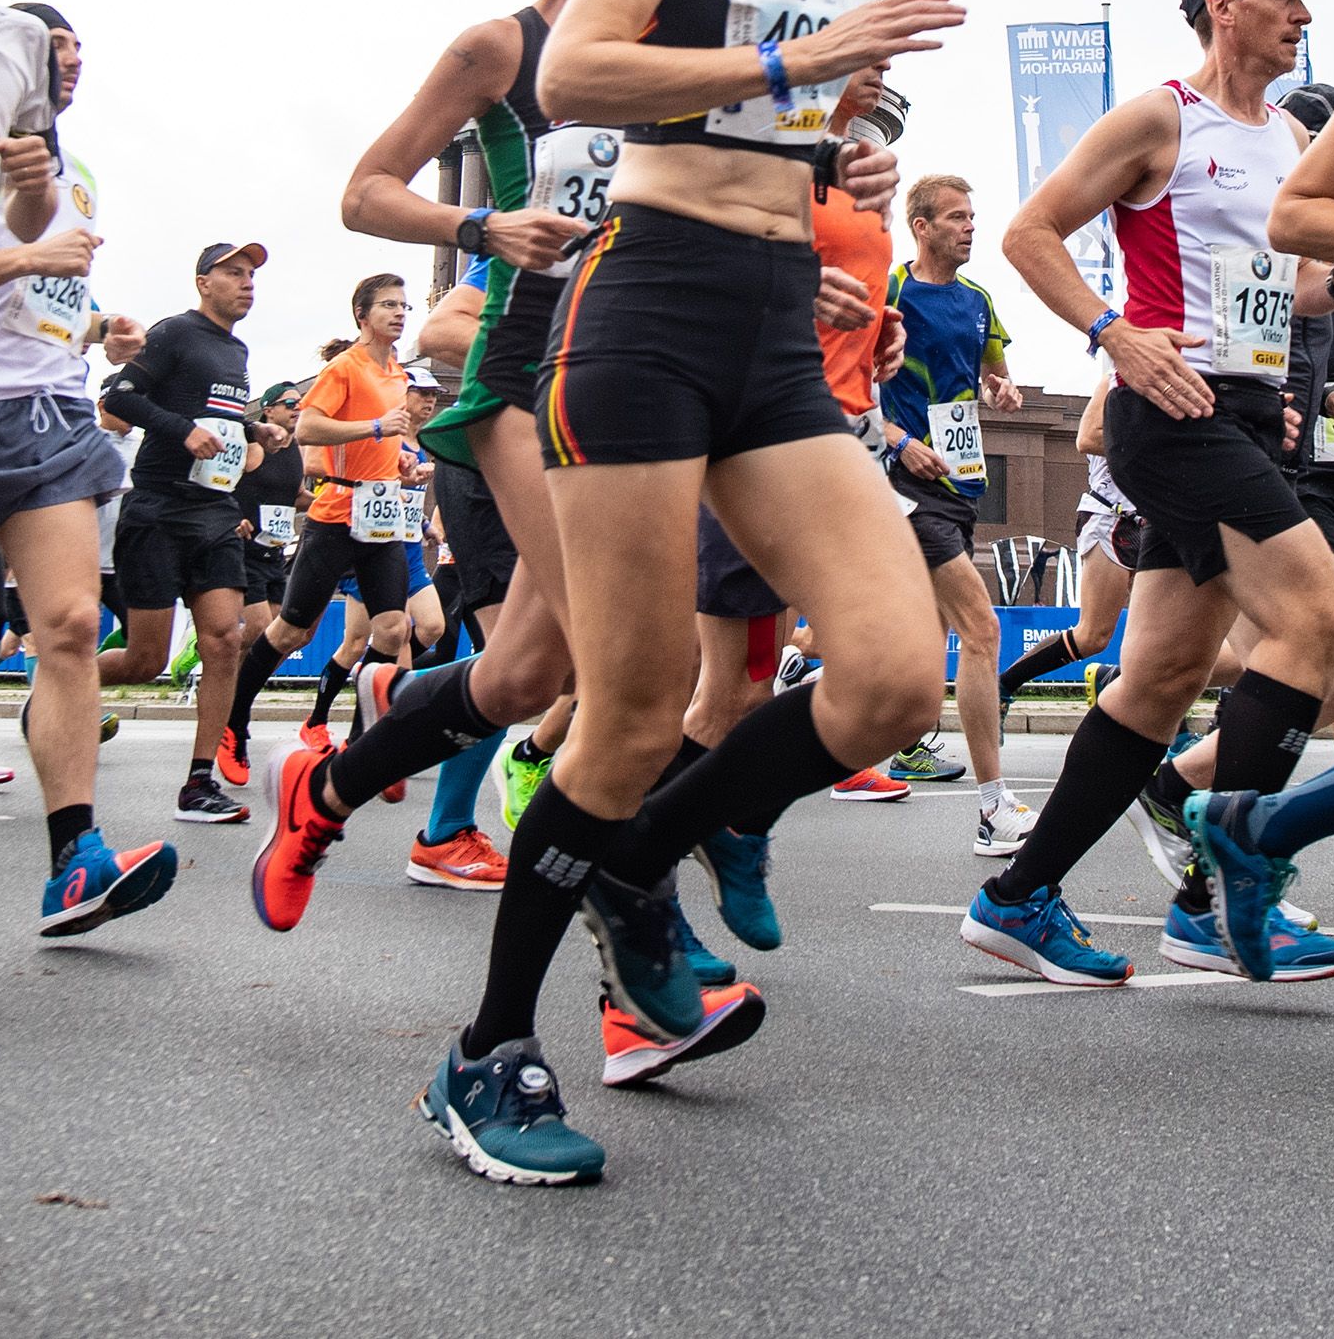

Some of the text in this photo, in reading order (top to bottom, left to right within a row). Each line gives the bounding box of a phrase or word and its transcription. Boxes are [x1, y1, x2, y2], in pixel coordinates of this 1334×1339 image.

[558, 175, 612, 222] 35
[1235, 287, 1295, 329] 1875
[1260, 327, 1283, 342] Viktor
[1255, 353, 1278, 365] Giti
[210, 382, 235, 397] COSTA
[959, 465, 976, 474] Giti
